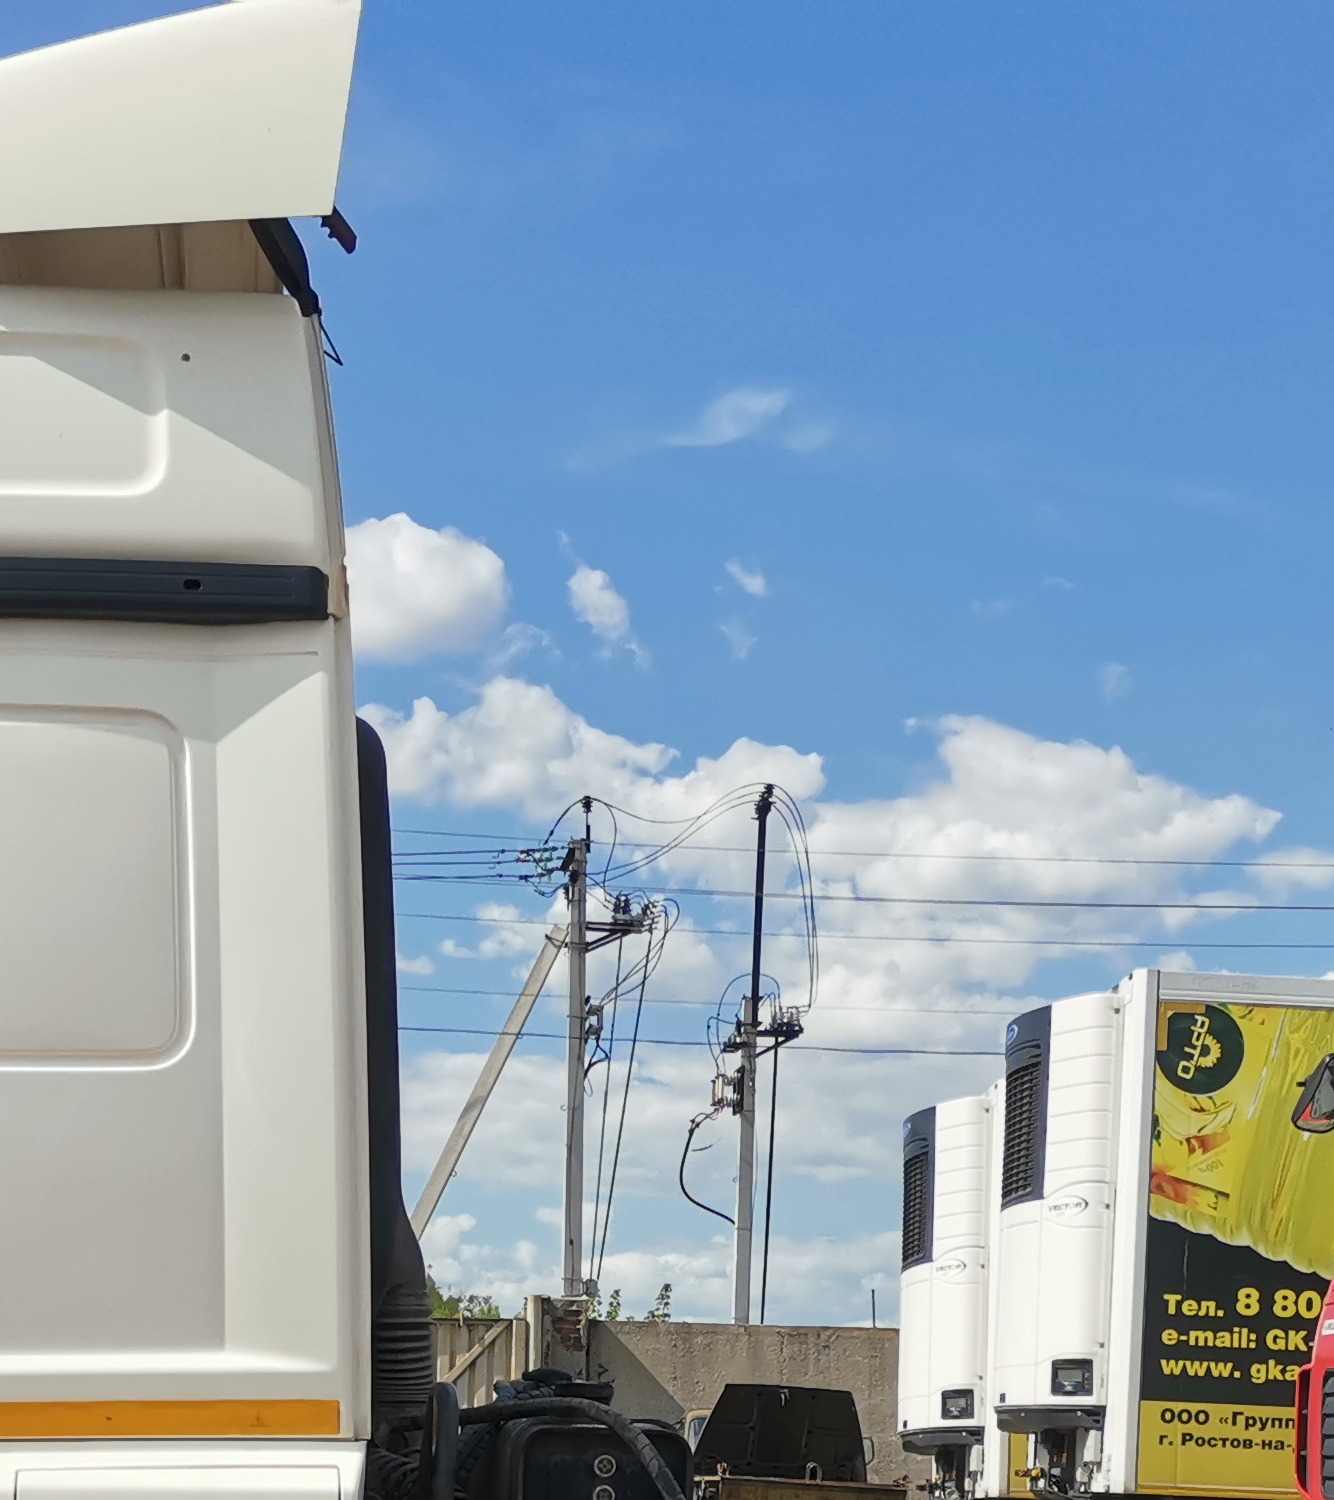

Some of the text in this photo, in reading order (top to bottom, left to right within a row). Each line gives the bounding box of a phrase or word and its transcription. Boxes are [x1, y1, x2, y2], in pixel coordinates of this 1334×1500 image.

[1048, 1202, 1083, 1213] VECTOR
[1163, 1287, 1322, 1319] Тел. 8 80
[1161, 1327, 1257, 1349] e-mail:
[1160, 1359, 1241, 1379] www.
[1160, 1408, 1209, 1425] ООО
[1158, 1432, 1295, 1454] г. Ростов-на-
